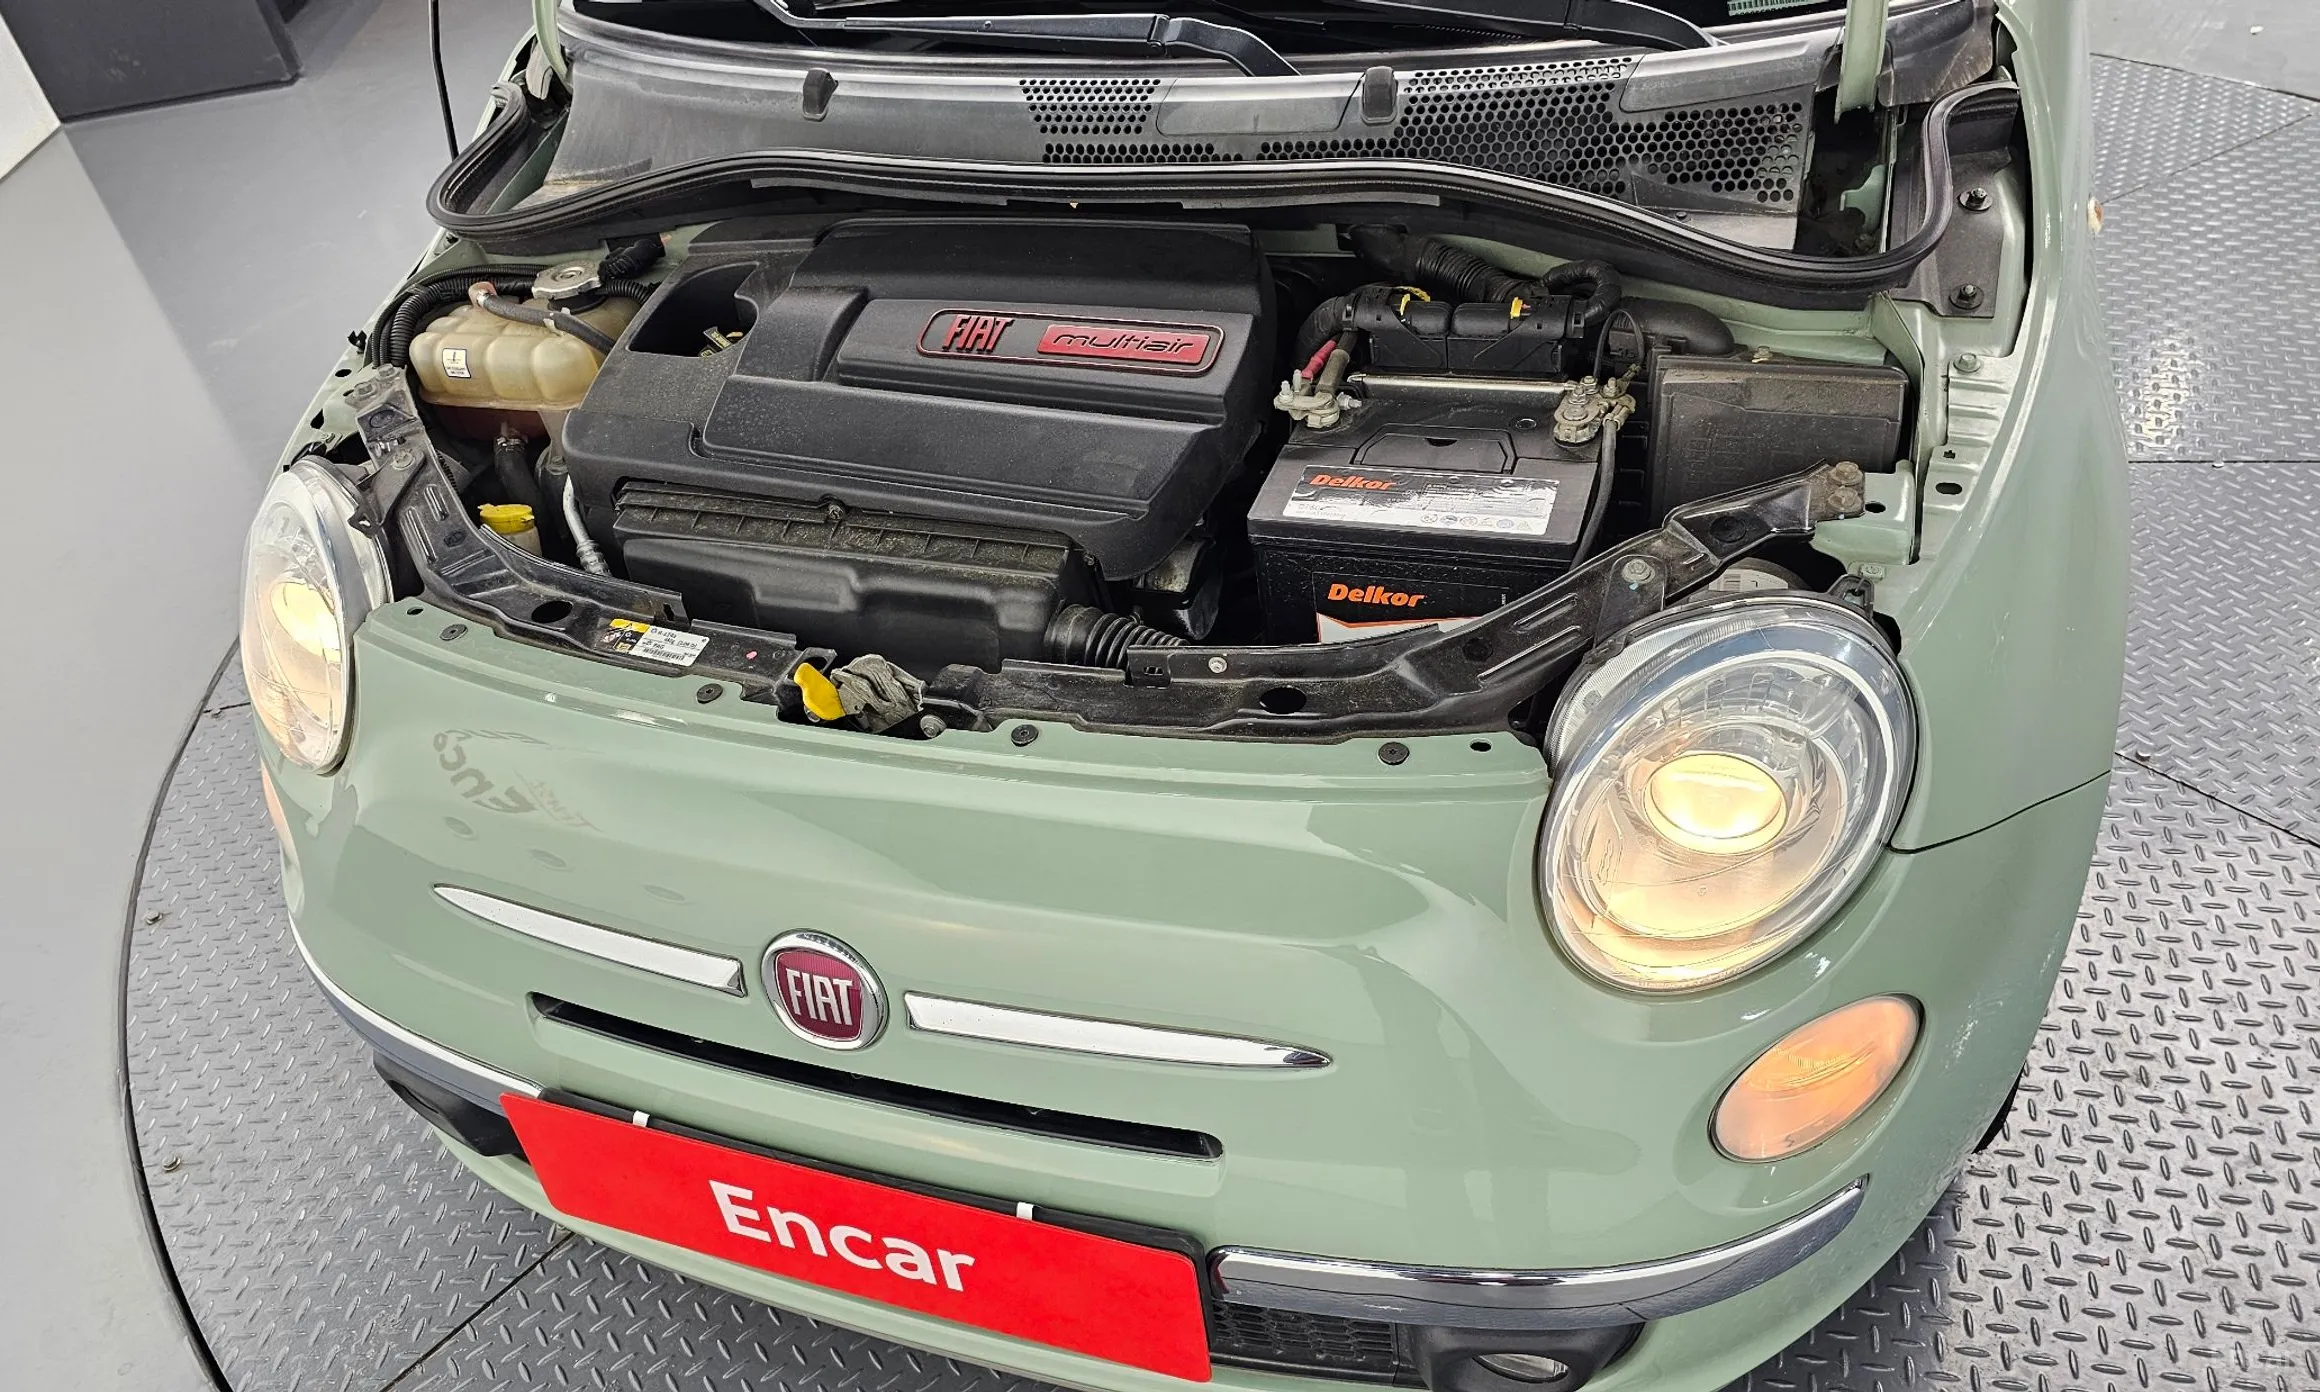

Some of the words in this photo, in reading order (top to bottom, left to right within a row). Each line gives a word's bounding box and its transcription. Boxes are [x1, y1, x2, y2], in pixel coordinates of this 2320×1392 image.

[942, 314, 1013, 352] FIAT
[1053, 333, 1193, 354] multiair
[1309, 474, 1397, 491] Delkor
[1327, 583, 1425, 607] Delkor
[785, 967, 853, 1026] FIAT
[708, 1180, 975, 1292] Encar
